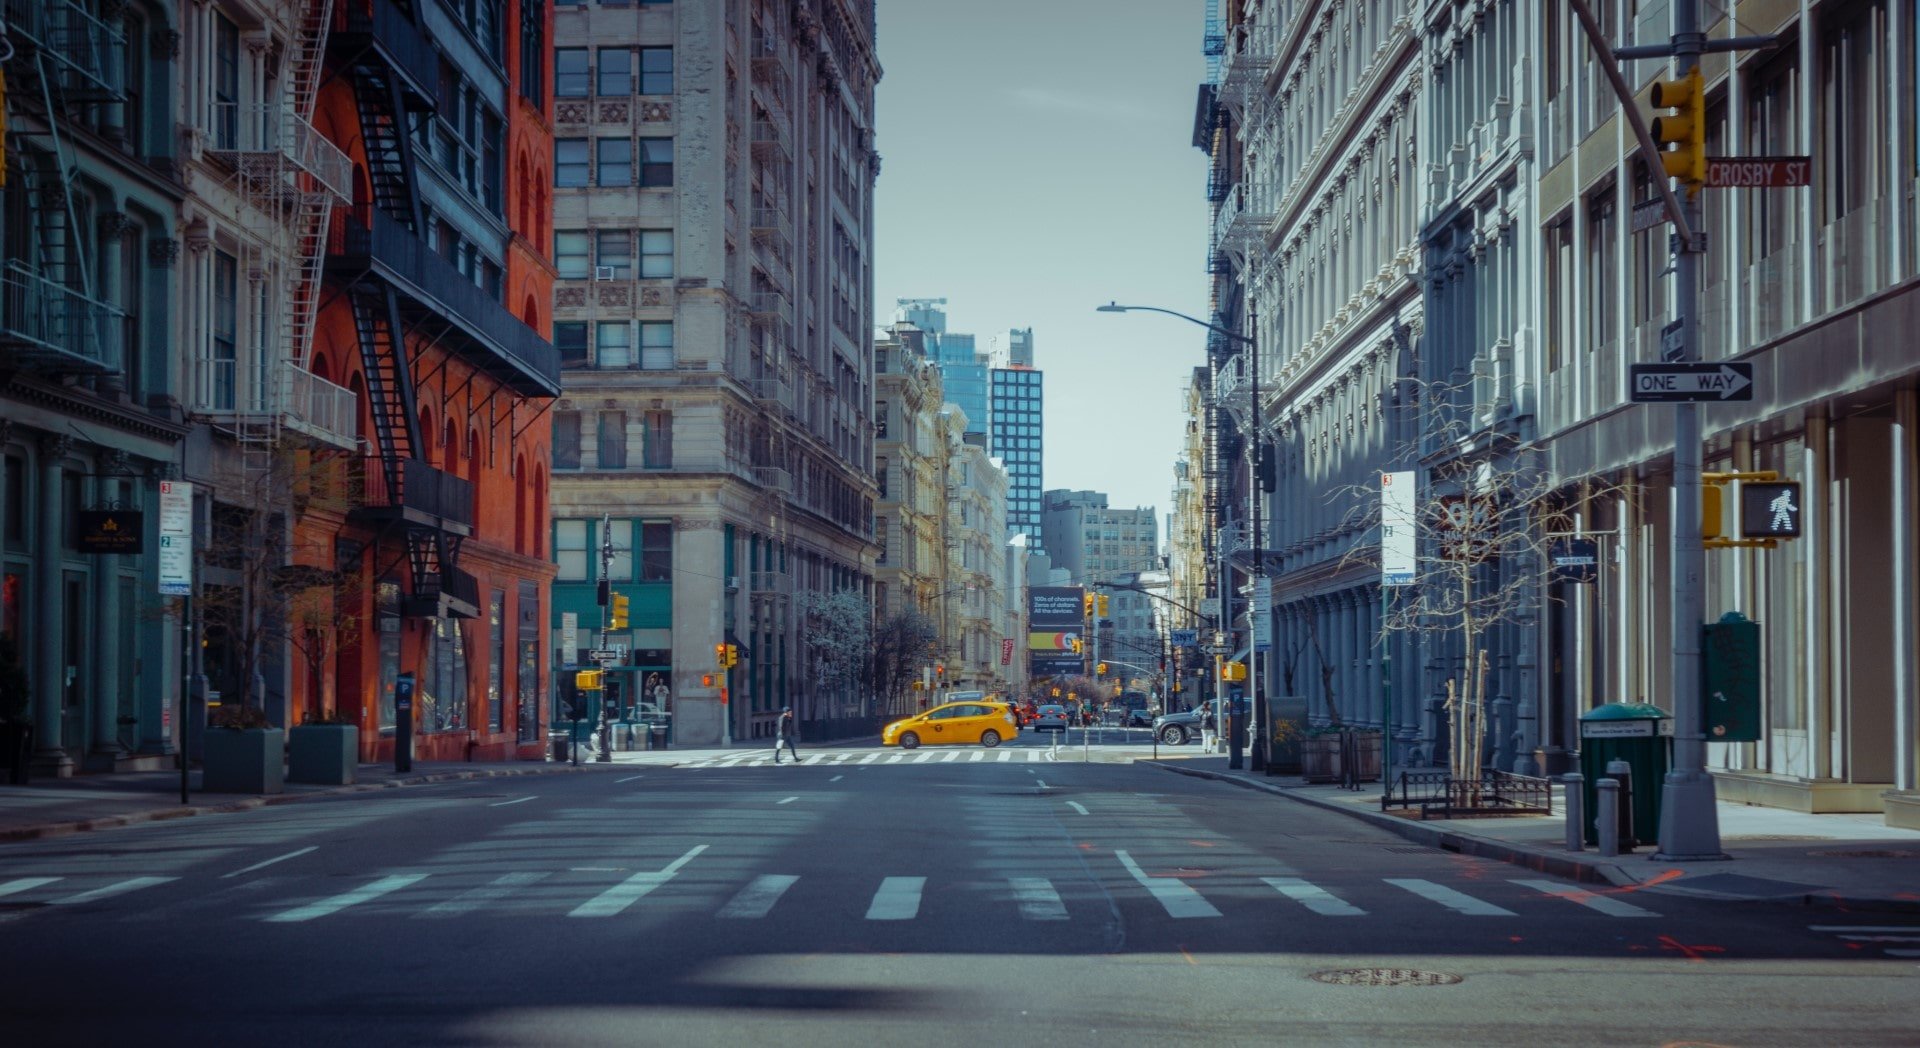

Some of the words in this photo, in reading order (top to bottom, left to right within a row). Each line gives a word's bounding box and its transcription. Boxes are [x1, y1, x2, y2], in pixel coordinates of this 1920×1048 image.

[1709, 163, 1775, 185] CROSBY
[1785, 163, 1806, 184] ST
[1641, 375, 1676, 390] ONE
[1697, 375, 1737, 390] WAY
[402, 684, 409, 694] P
